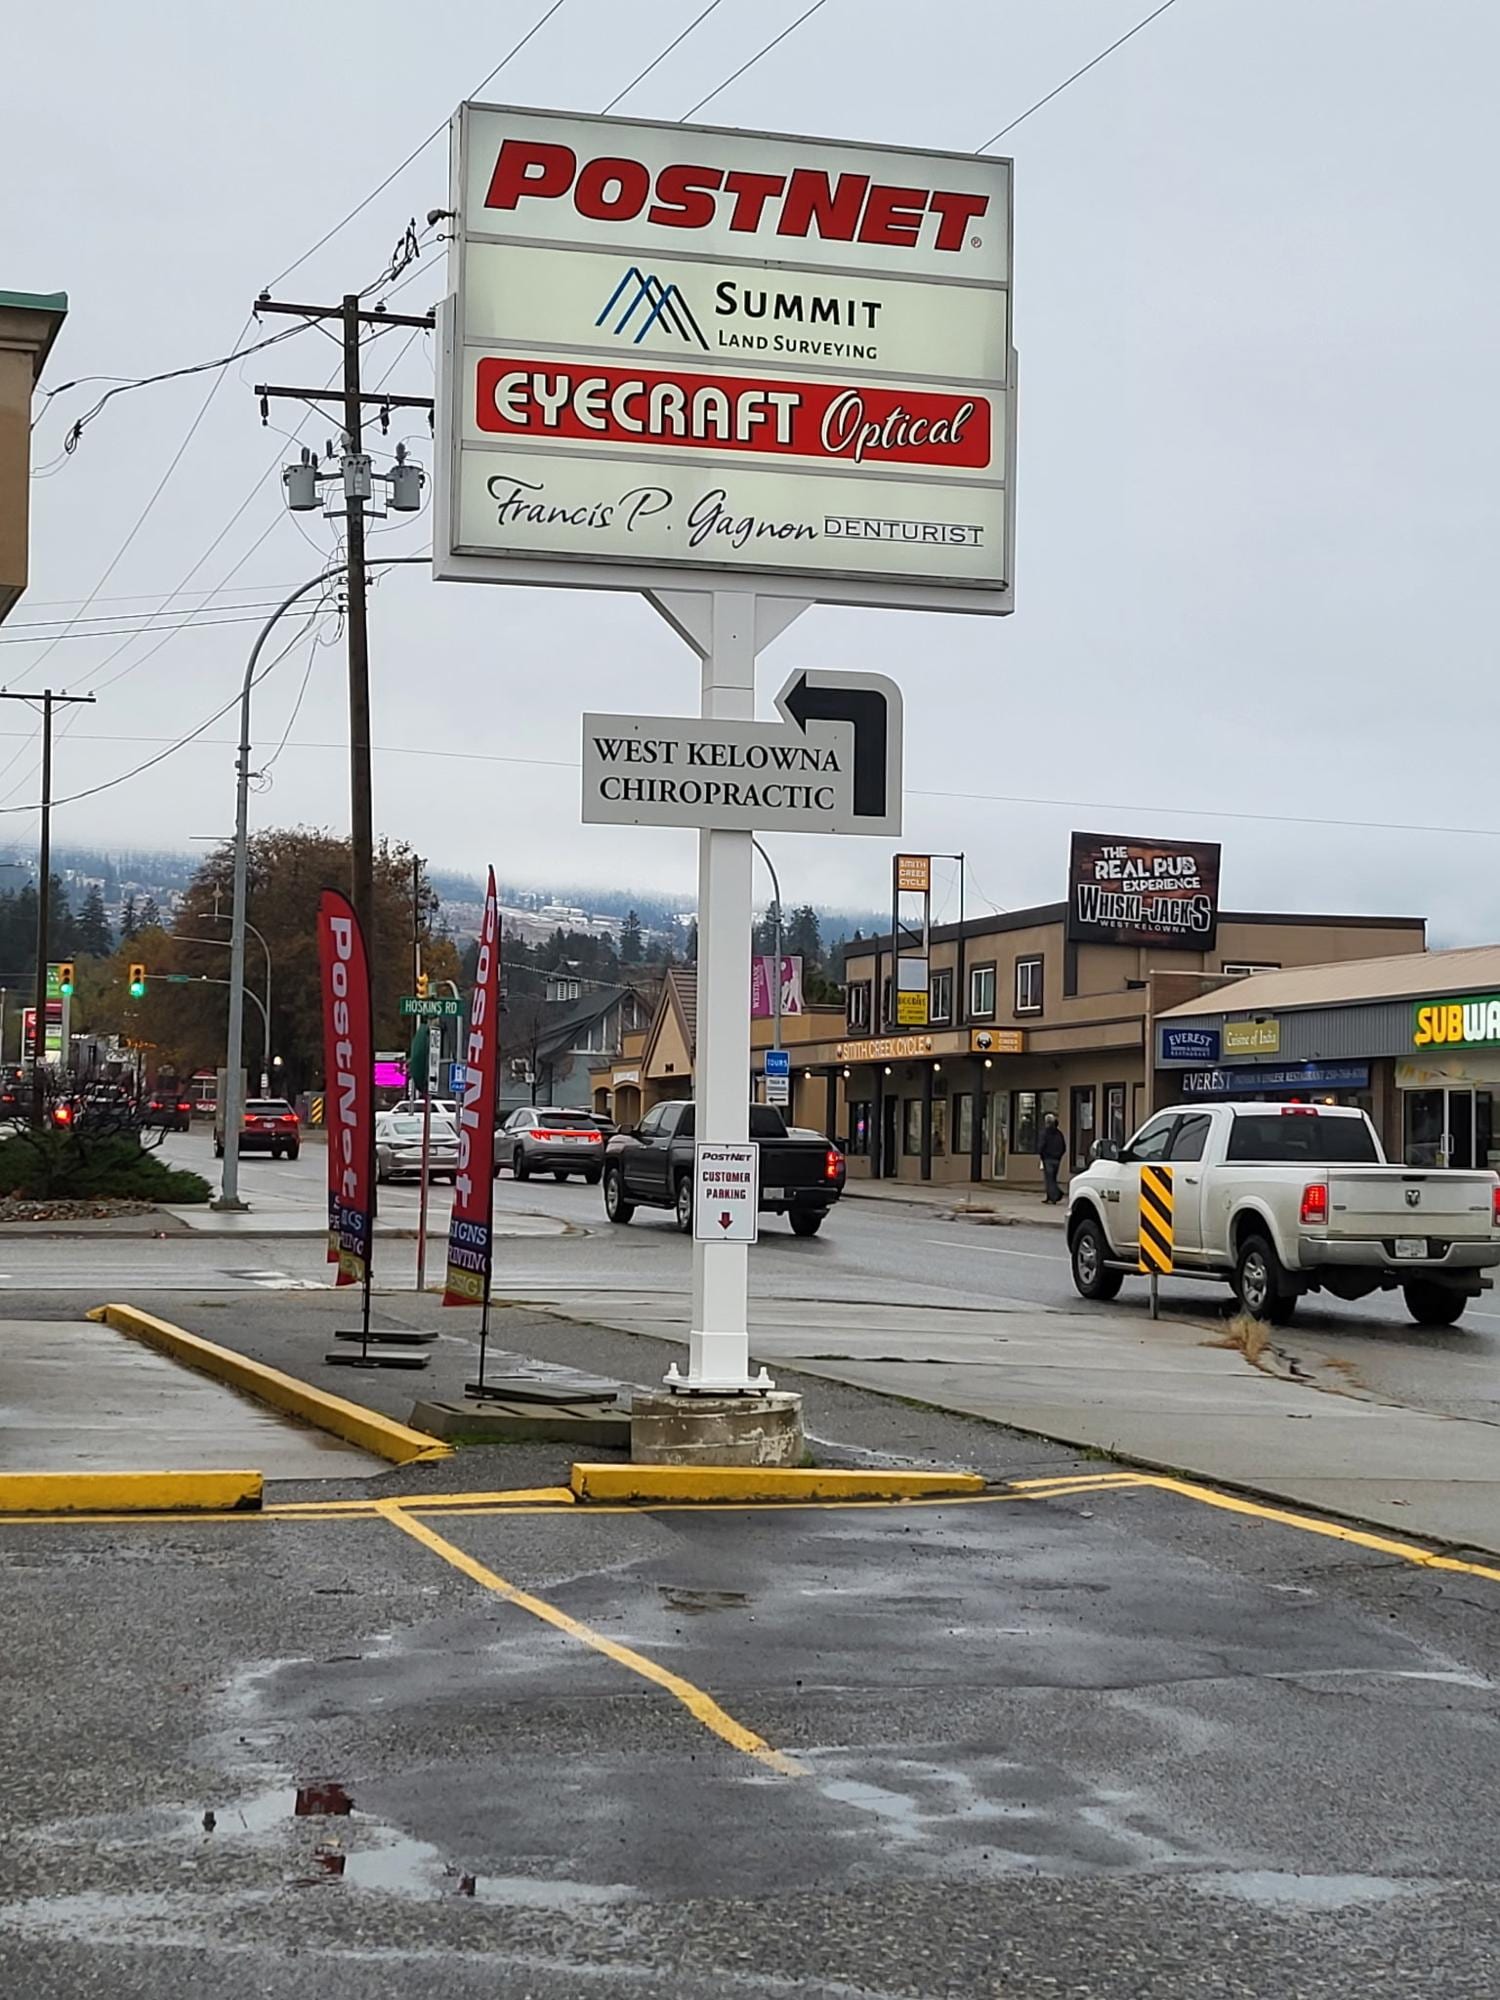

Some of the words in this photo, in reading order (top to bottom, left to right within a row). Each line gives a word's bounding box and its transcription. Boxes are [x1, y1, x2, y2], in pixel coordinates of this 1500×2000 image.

[715, 281, 882, 330] SUMMIT
[718, 329, 769, 352] LAND
[774, 334, 878, 360] SURVEYING
[494, 371, 800, 444] EYECRAFT
[820, 390, 974, 464] Optical
[487, 475, 614, 530] Francis
[618, 486, 671, 533] P.
[687, 488, 819, 548] Gagnon
[824, 518, 984, 545] DENTURIST
[593, 737, 679, 764] WEST
[687, 742, 842, 772] KELOWNA
[599, 776, 835, 810] CHIROPRACTIC
[1101, 846, 1128, 859] THE
[899, 869, 926, 877] CREEK
[900, 859, 926, 868] SMITH
[1094, 859, 1150, 880] REAL
[1153, 856, 1197, 877] PUB
[899, 878, 926, 886] CYCLE
[1123, 877, 1201, 892] EXPERIENCE
[1100, 920, 1130, 929] WEST
[1134, 923, 1186, 934] KELOWNA
[405, 999, 442, 1015] HOSKINS
[445, 1001, 457, 1014] RD
[1414, 1000, 1500, 1047] SUBWA
[843, 1041, 867, 1060] SMITH
[868, 1038, 895, 1058] CREEK
[896, 1037, 925, 1055] CYCLE
[1168, 1032, 1213, 1047] EVEREST
[330, 916, 358, 1199] PostNet
[1182, 1071, 1233, 1091] EVEREST
[702, 1171, 751, 1183] CUSTOMER
[706, 1188, 746, 1199] PARKING
